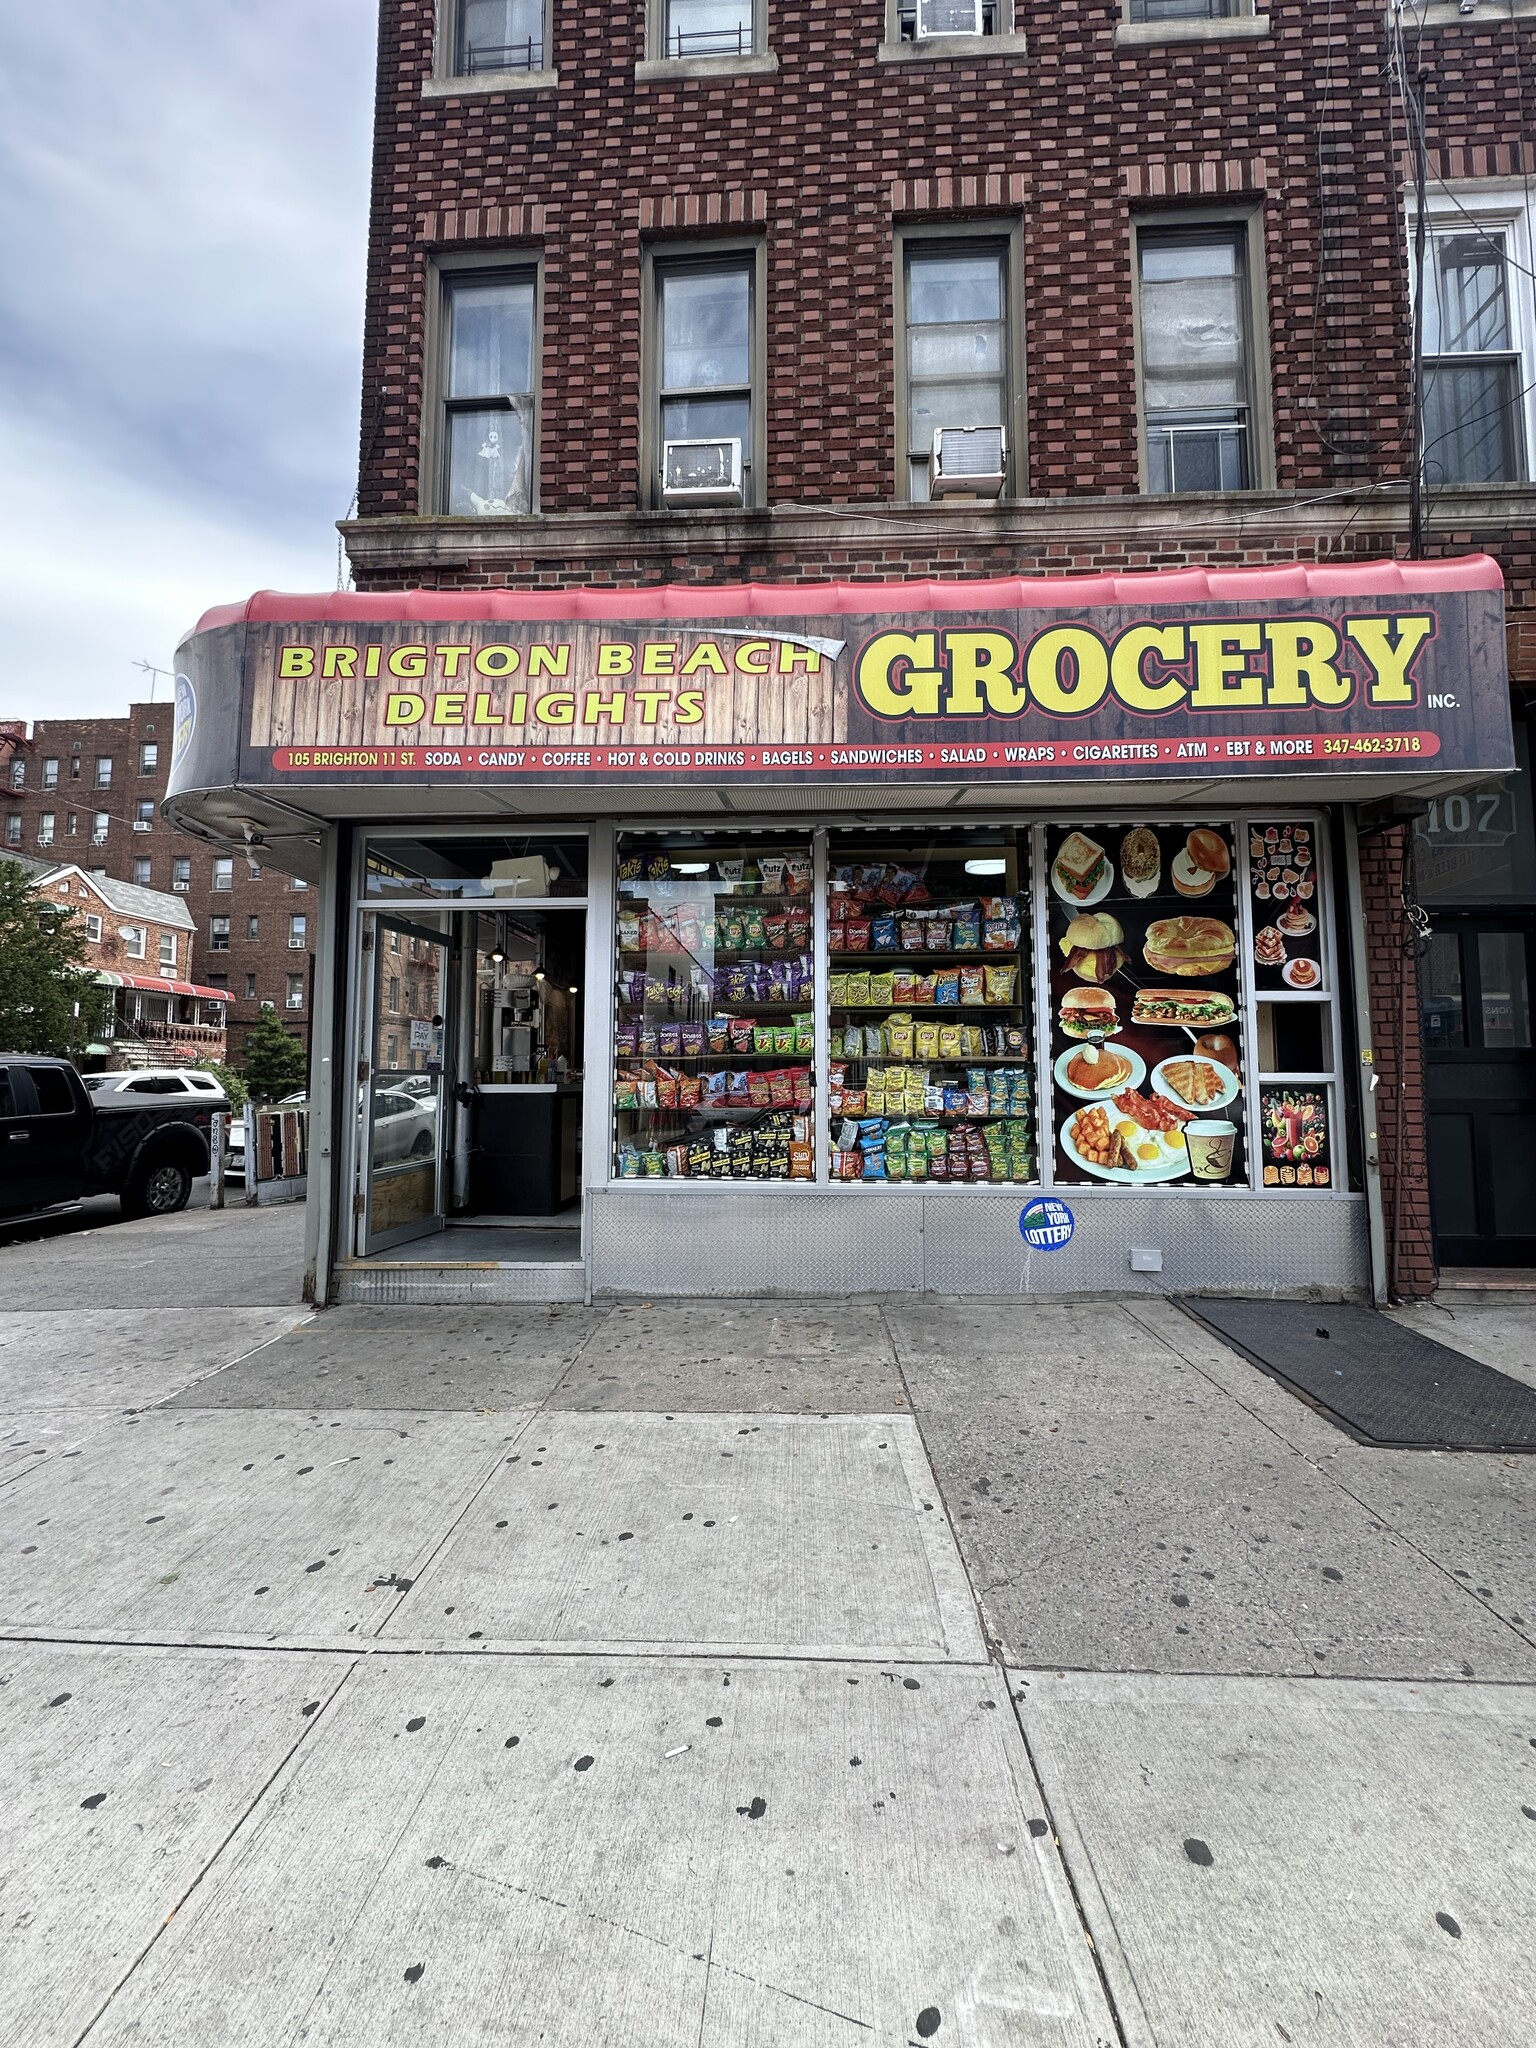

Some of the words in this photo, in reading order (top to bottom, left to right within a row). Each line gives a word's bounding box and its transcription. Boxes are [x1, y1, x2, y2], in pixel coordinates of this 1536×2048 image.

[279, 644, 571, 678] BRIGTON
[597, 640, 822, 676] BEACH
[857, 615, 1432, 717] GROCERY
[1427, 693, 1461, 709] INC.
[385, 690, 705, 726] DELIGHTS
[288, 752, 309, 766] 105
[313, 752, 378, 767] BRIGHTON
[383, 752, 396, 766] 11
[400, 752, 416, 766] ST.
[425, 752, 461, 767] SODA
[478, 752, 525, 767] CANDY
[542, 752, 591, 767] COFFEE
[608, 752, 636, 766] HOT
[639, 752, 649, 766] &
[653, 752, 691, 766] COLD
[694, 751, 745, 766] DRINKS
[762, 751, 813, 766] BAGELS
[830, 749, 922, 765] SANDWICHES
[940, 747, 986, 763] SALAD
[1004, 746, 1055, 762] WRAPS
[1073, 744, 1158, 760] CIGARETTES
[1176, 742, 1207, 758] ATM
[1226, 741, 1250, 757] EBT
[1255, 741, 1266, 756] &
[1270, 740, 1313, 756] MORE
[1323, 737, 1421, 754] 347-462-3718
[1428, 794, 1500, 833] 107
[1044, 1202, 1064, 1212] NEW
[1046, 1212, 1070, 1225] YORK
[1025, 1224, 1072, 1244] LOTTERY
